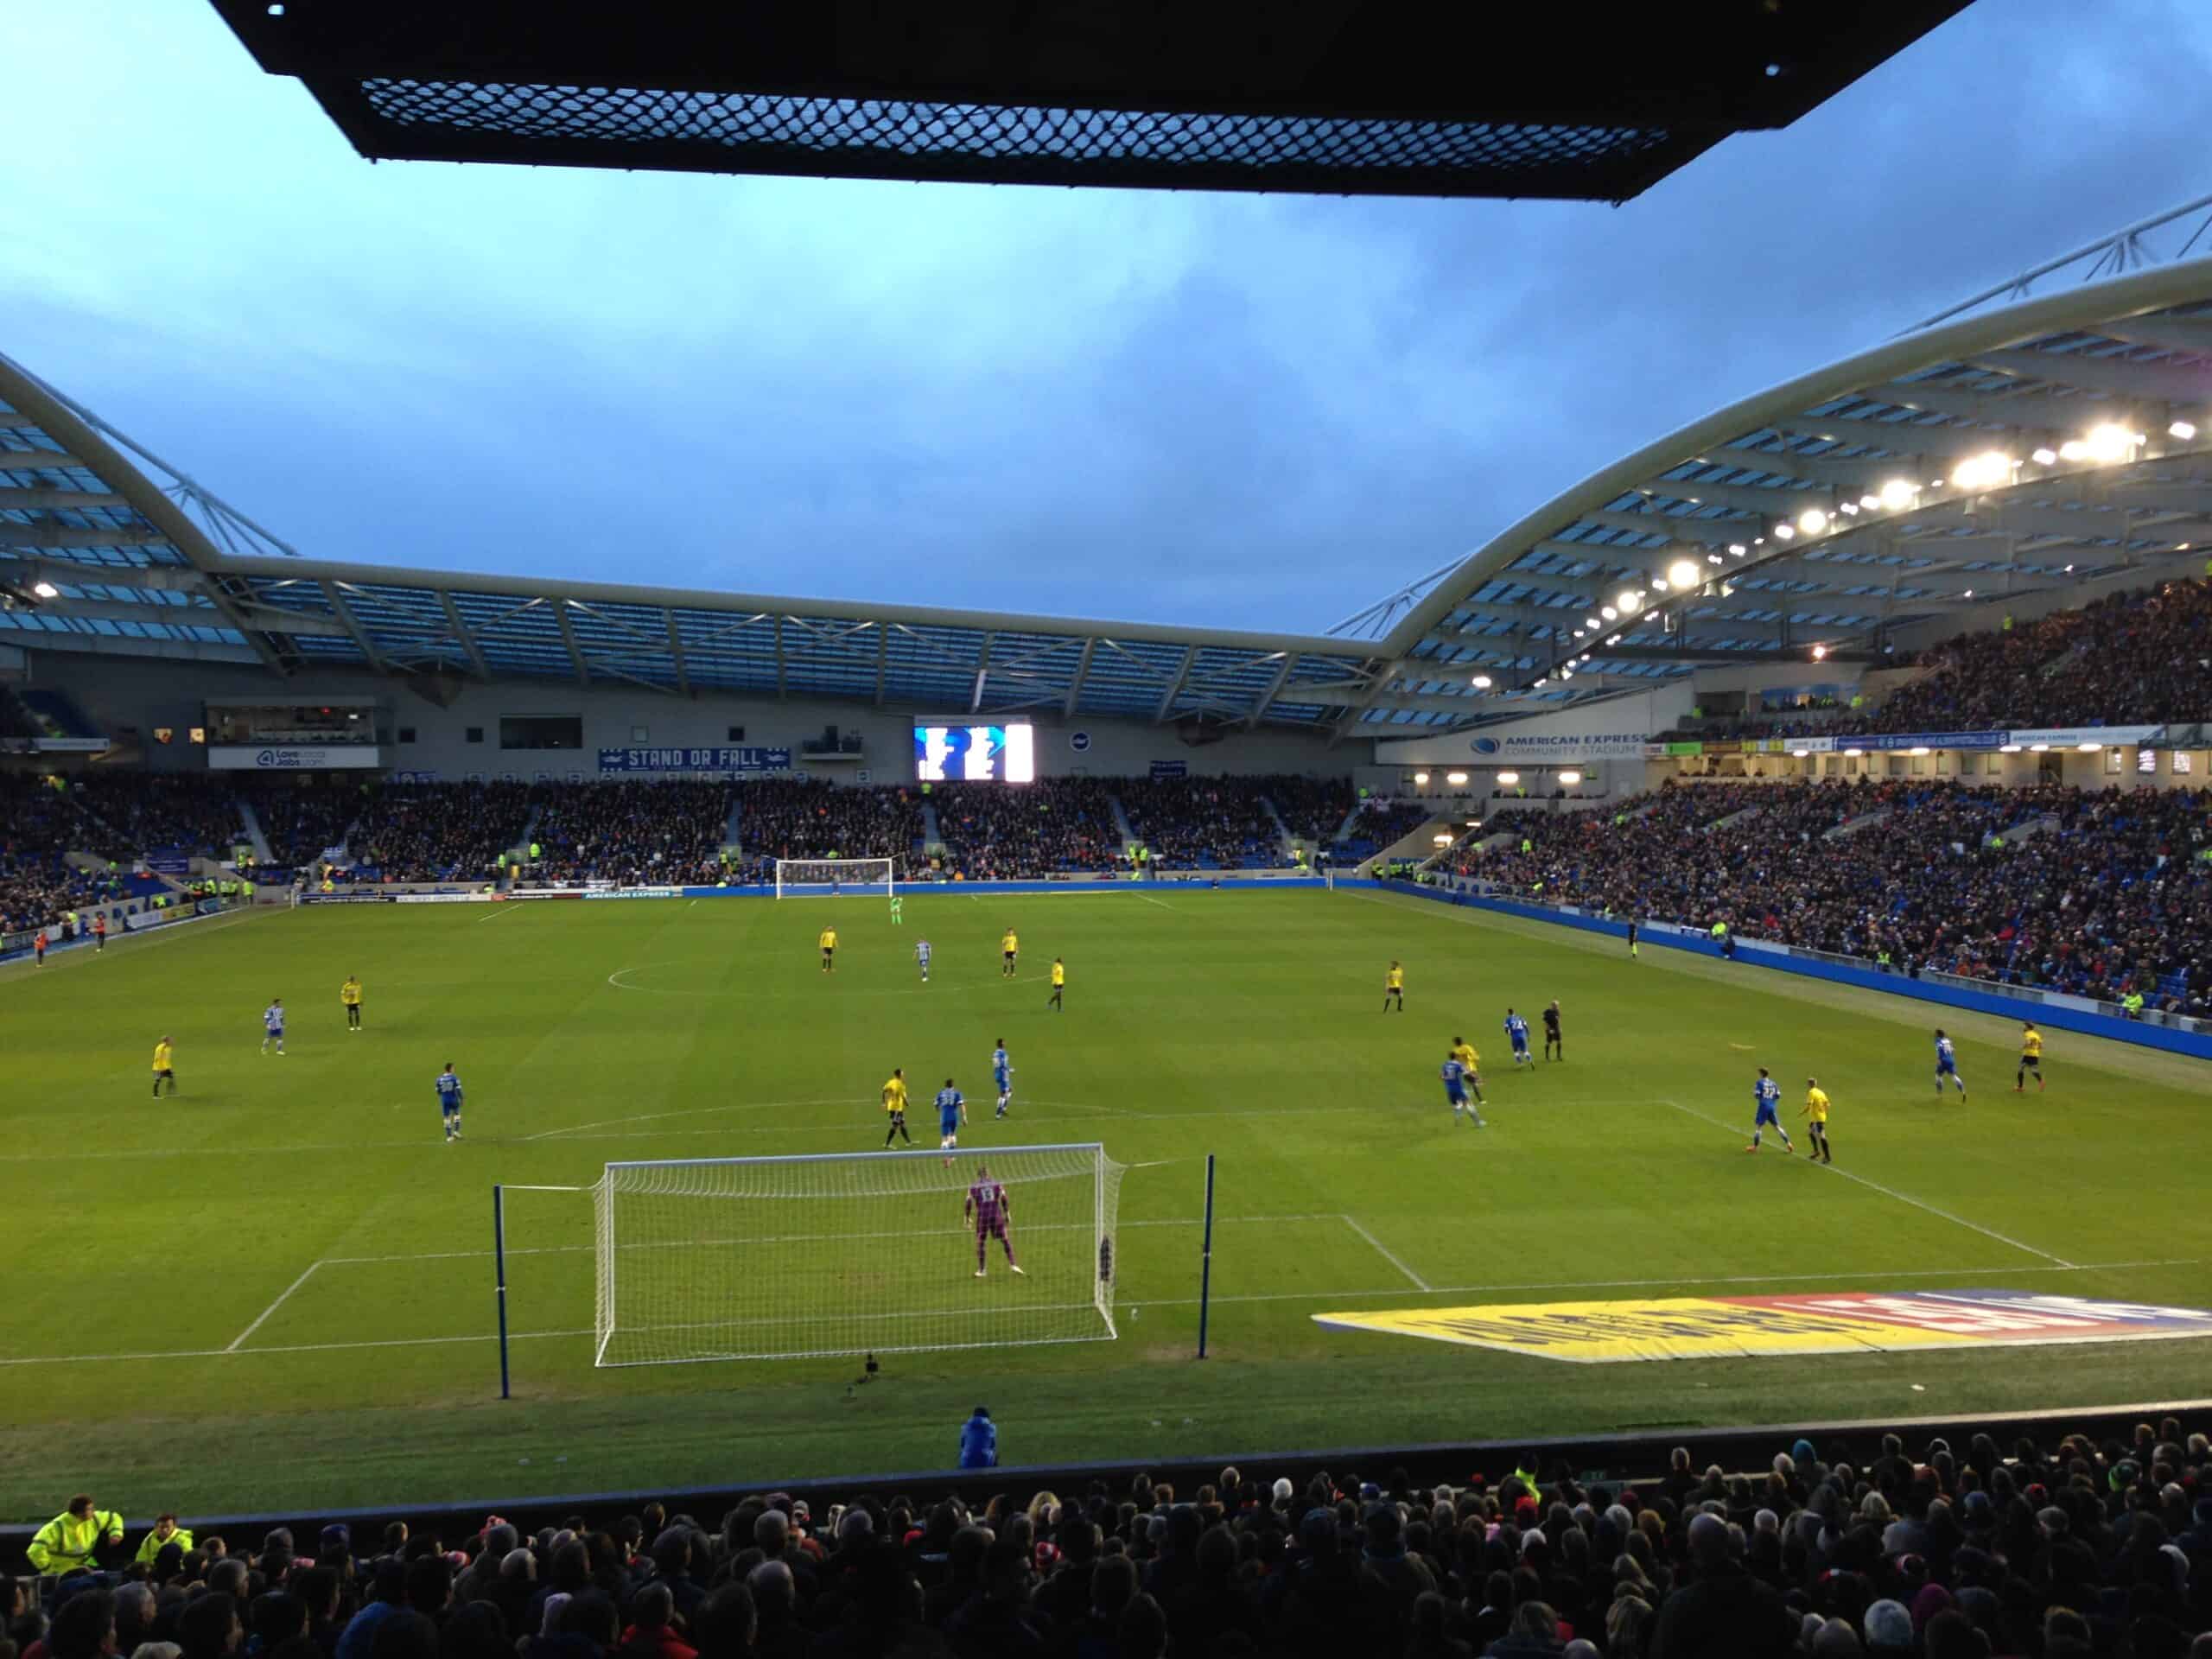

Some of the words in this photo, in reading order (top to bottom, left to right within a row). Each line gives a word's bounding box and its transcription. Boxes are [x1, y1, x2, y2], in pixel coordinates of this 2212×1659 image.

[1506, 736, 1580, 746] AMERICAN
[1504, 746, 1576, 755] COMMUNITY
[1582, 744, 1637, 754] STADIUM
[628, 750, 683, 766] STAND
[690, 750, 712, 766] OR
[719, 749, 761, 766] FALL
